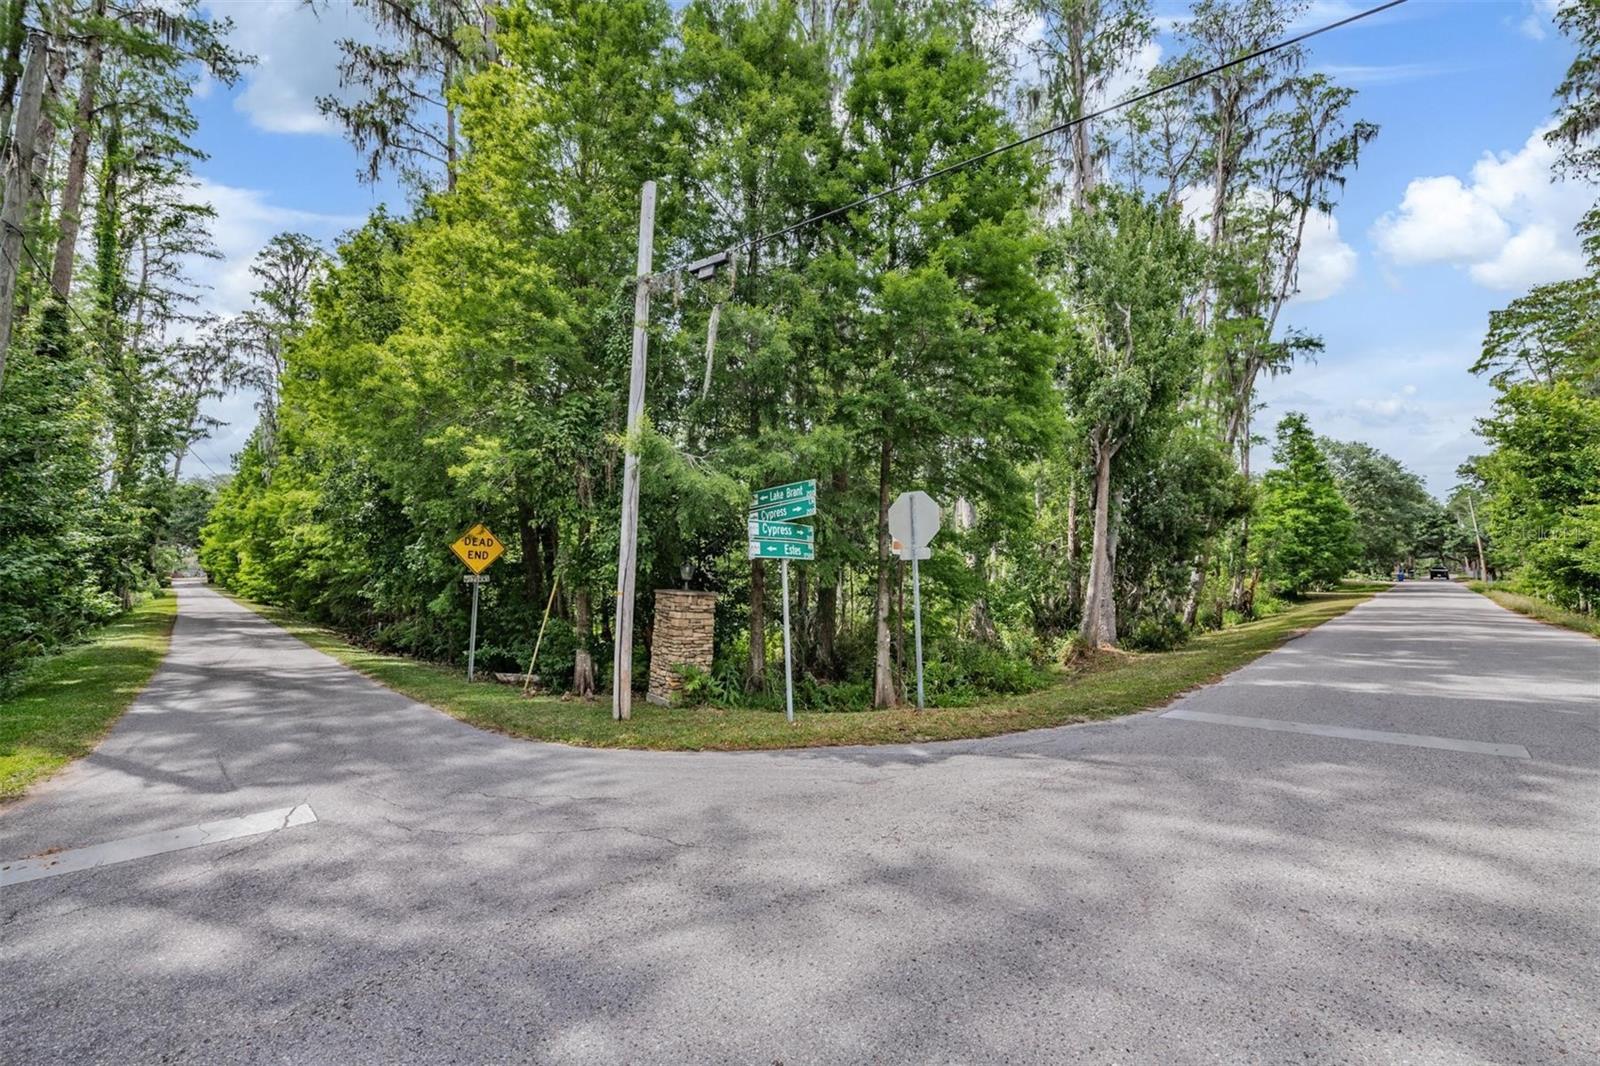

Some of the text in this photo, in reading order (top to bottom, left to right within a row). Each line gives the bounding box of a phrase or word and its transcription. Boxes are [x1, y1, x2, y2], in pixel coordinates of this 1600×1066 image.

[769, 489, 784, 501] Lake
[786, 485, 803, 498] Brant
[761, 508, 787, 521] Cypress
[762, 523, 792, 536] Cypress
[464, 537, 493, 547] DEAD
[468, 550, 489, 560] END
